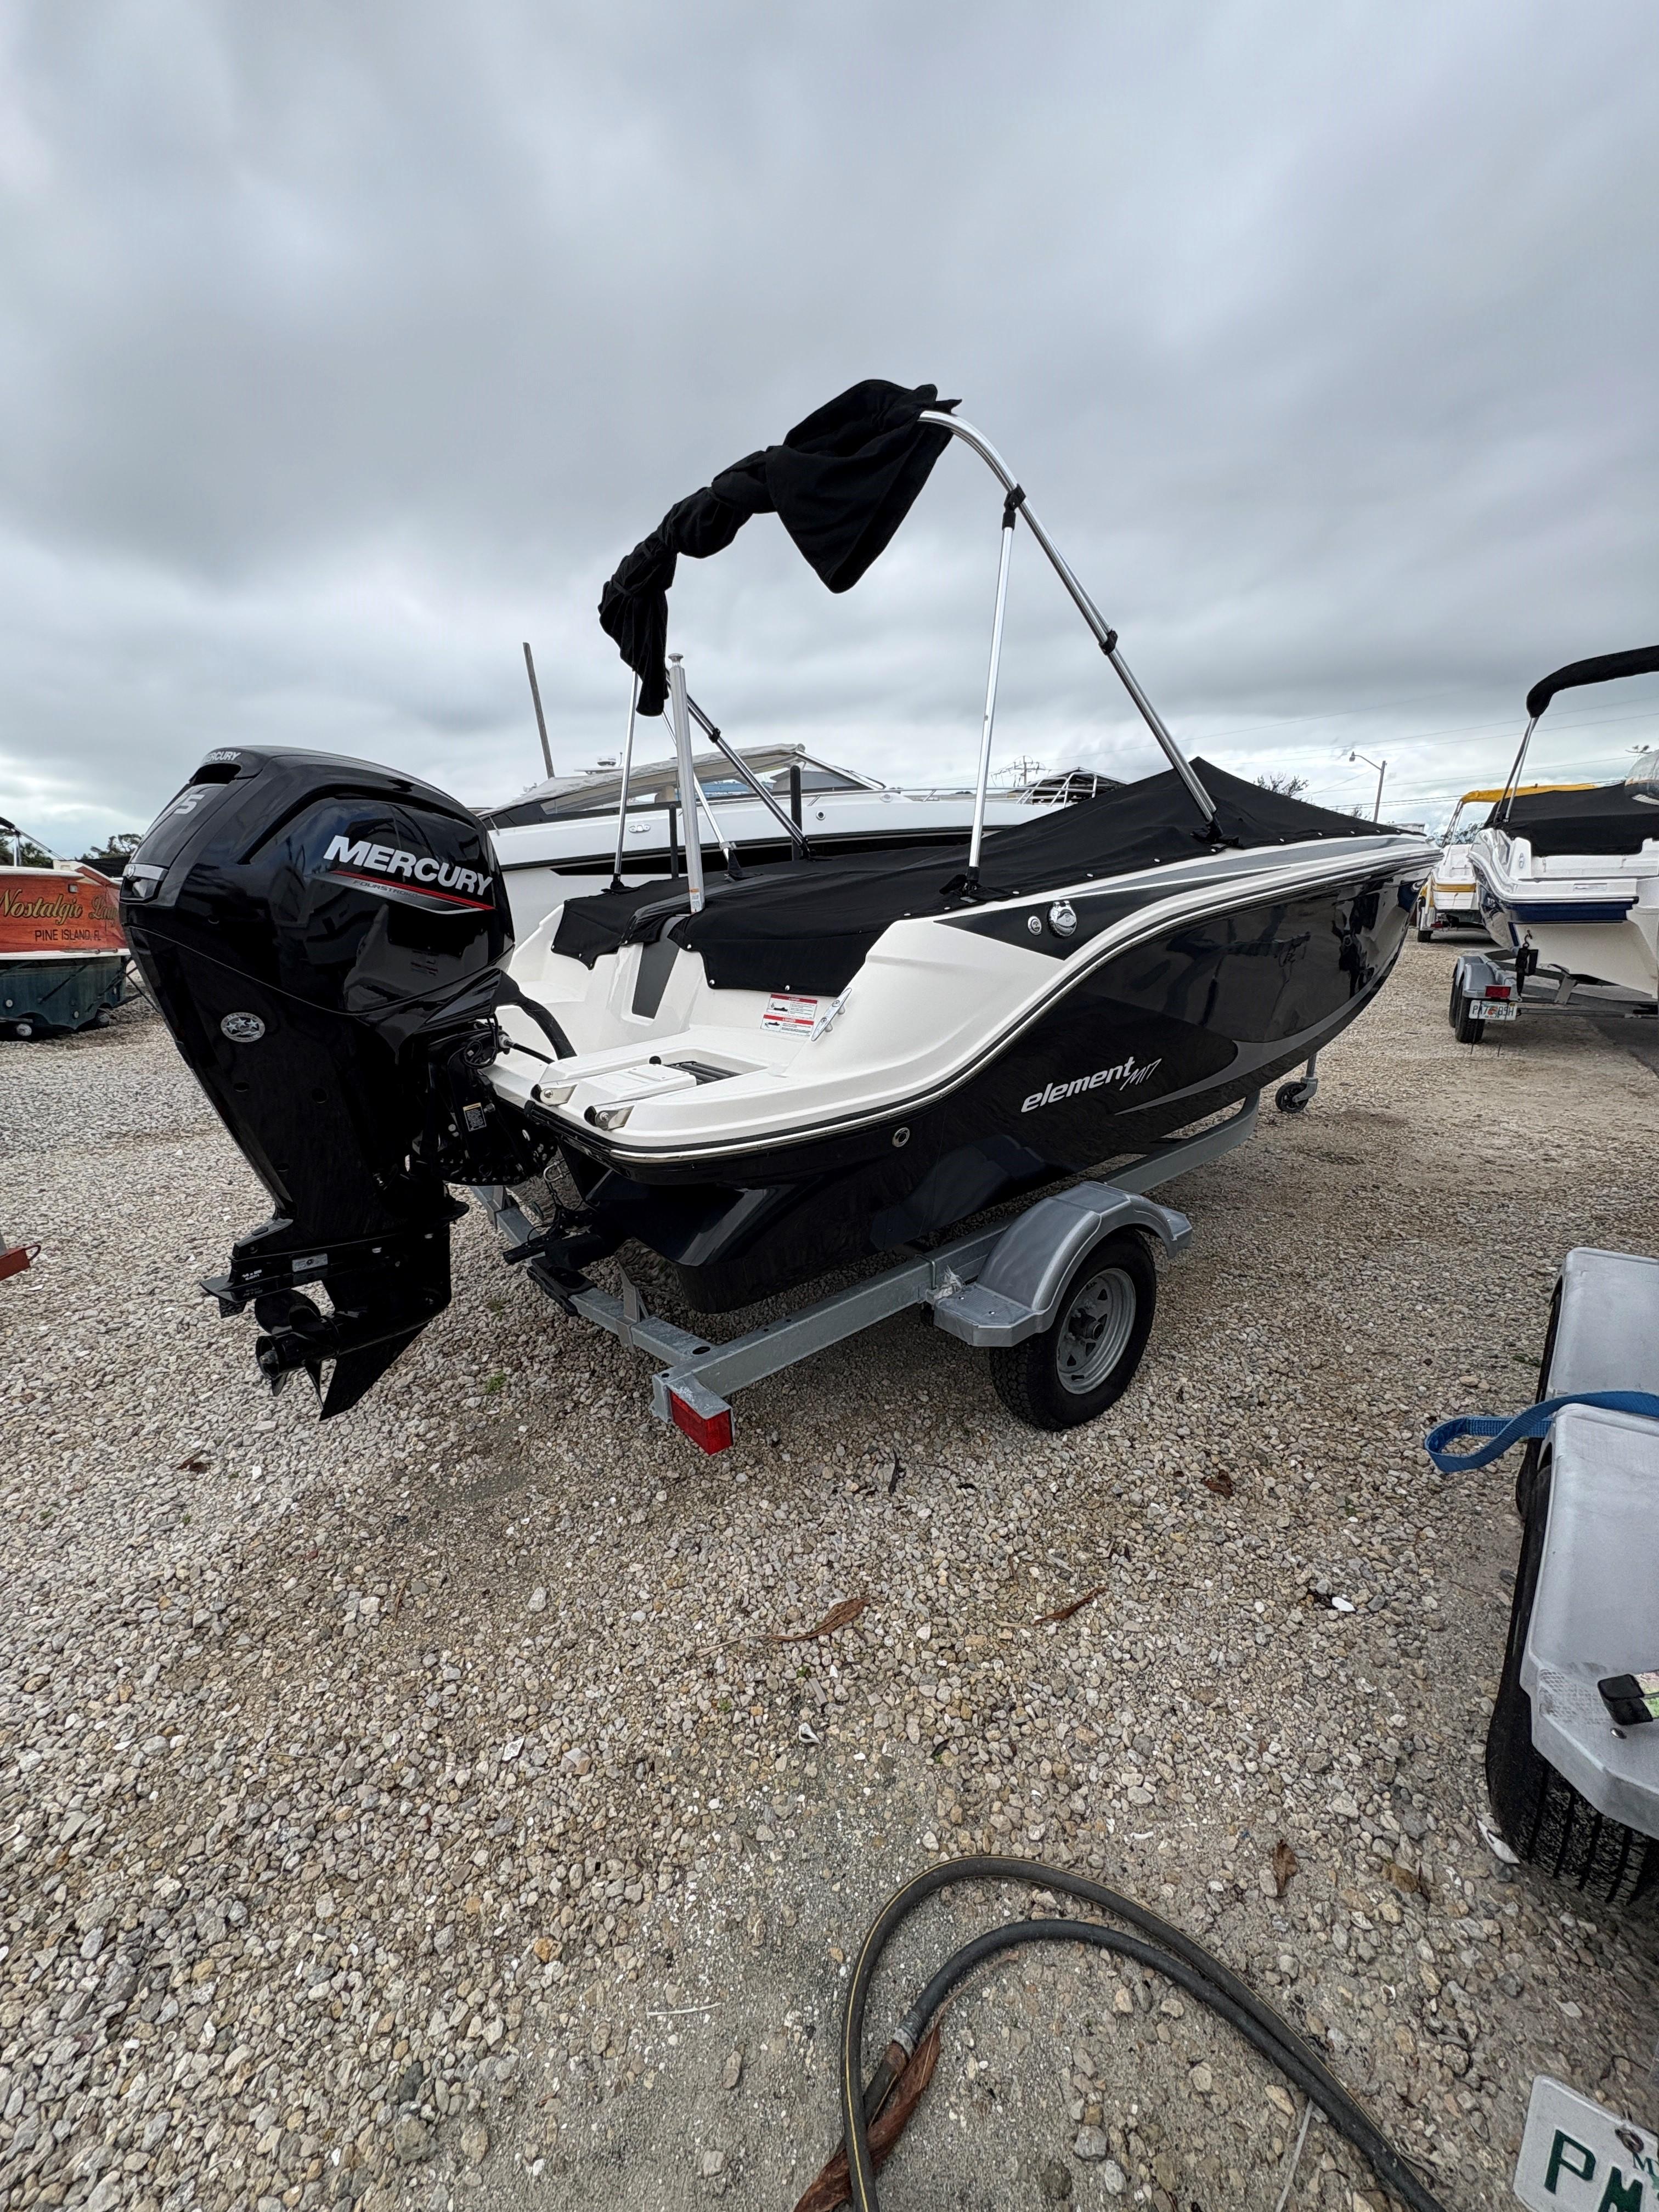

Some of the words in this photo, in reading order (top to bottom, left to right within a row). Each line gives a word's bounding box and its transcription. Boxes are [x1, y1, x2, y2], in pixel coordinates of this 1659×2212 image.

[204, 751, 241, 763] ERCURY
[168, 794, 205, 815] 5
[323, 835, 493, 896] MERCURY
[353, 879, 418, 898] FOURSTROKE
[0, 889, 83, 925] Nostalgic
[35, 930, 58, 941] PINE
[61, 929, 92, 941] ISLAND,
[1021, 1057, 1135, 1113] element
